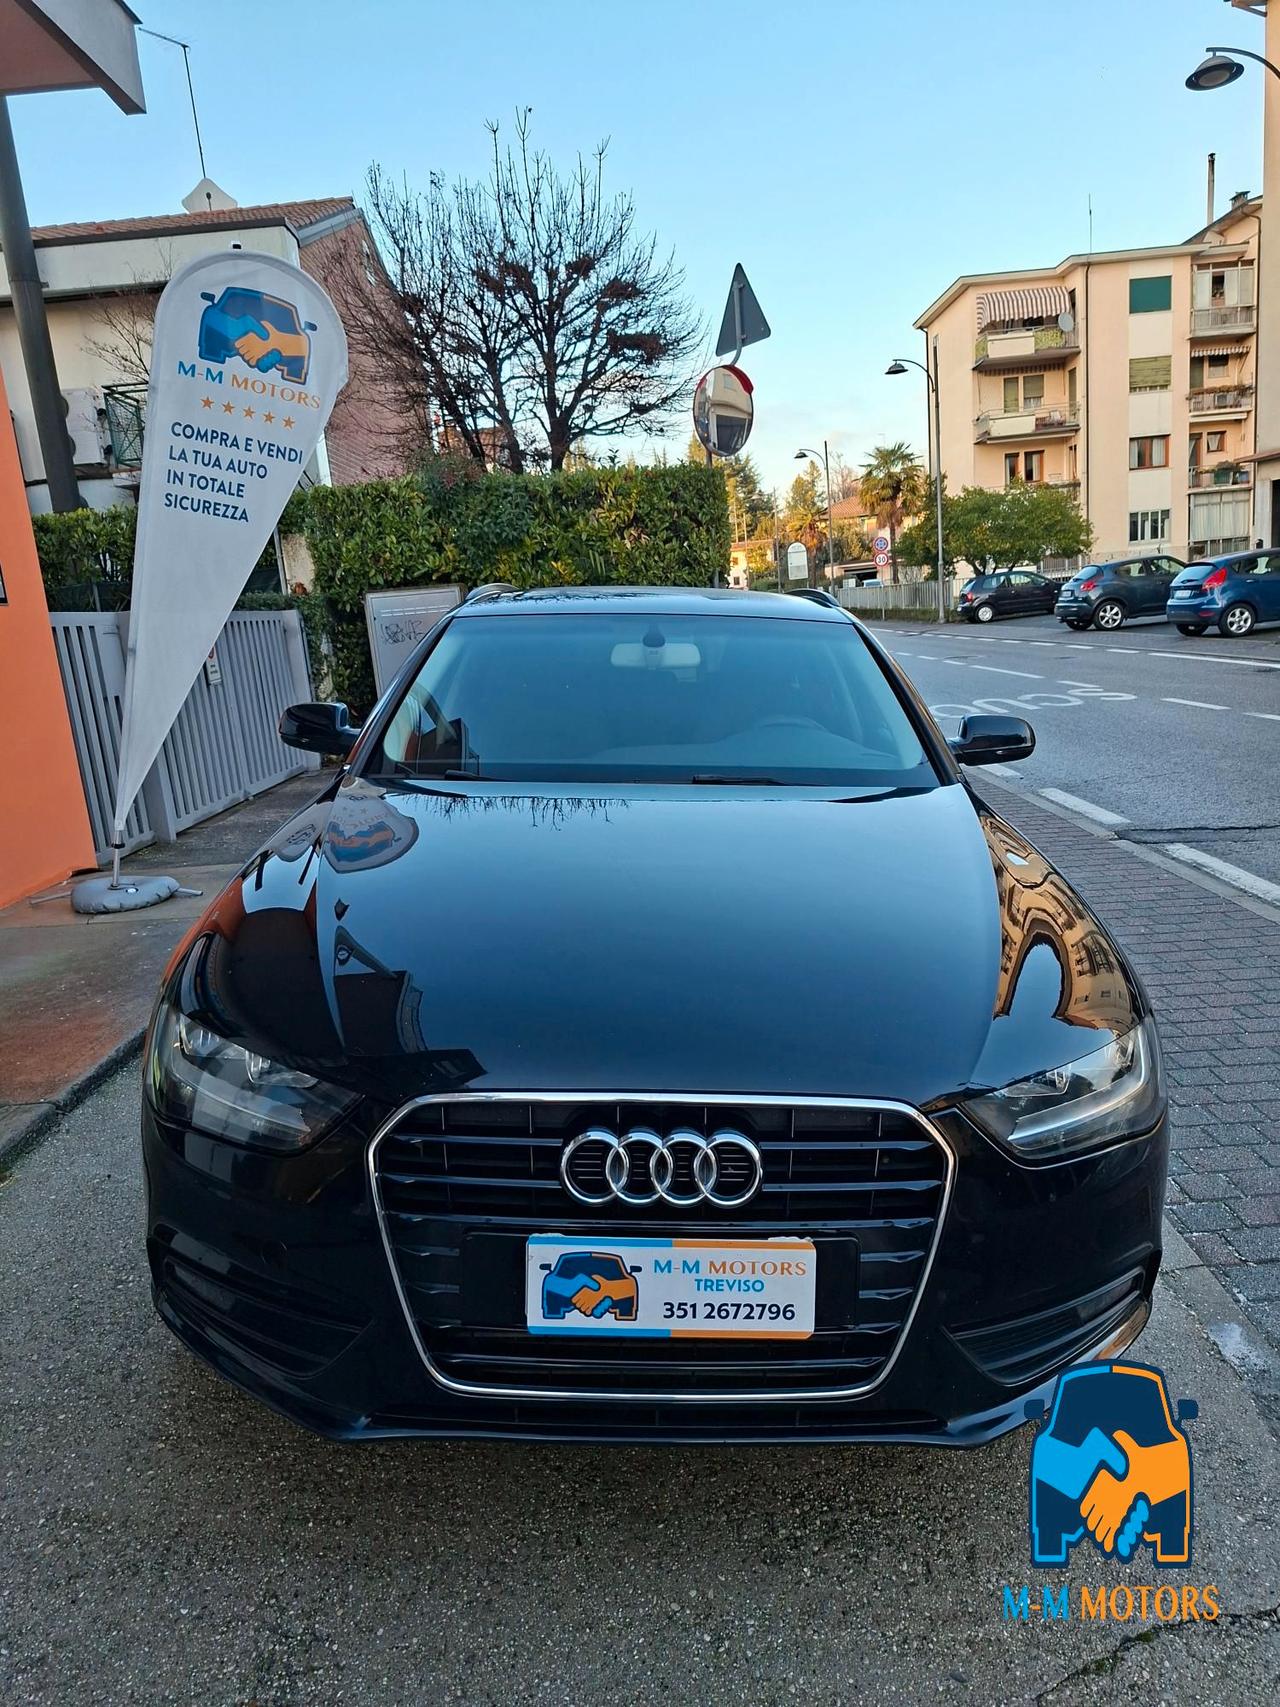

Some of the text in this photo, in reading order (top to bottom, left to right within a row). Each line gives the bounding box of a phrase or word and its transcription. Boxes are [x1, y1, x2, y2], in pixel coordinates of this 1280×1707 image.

[177, 360, 321, 410] M-M MOTORS
[171, 421, 303, 465] COMPRA E VENDI
[168, 445, 268, 479] LA TUA AUTO
[166, 469, 245, 498] IN TOTALE
[164, 492, 249, 523] SICUREZZA
[654, 1259, 807, 1277] M-M MOTORS
[694, 1278, 765, 1293] TREVISO
[663, 1302, 796, 1321] 351 2672796
